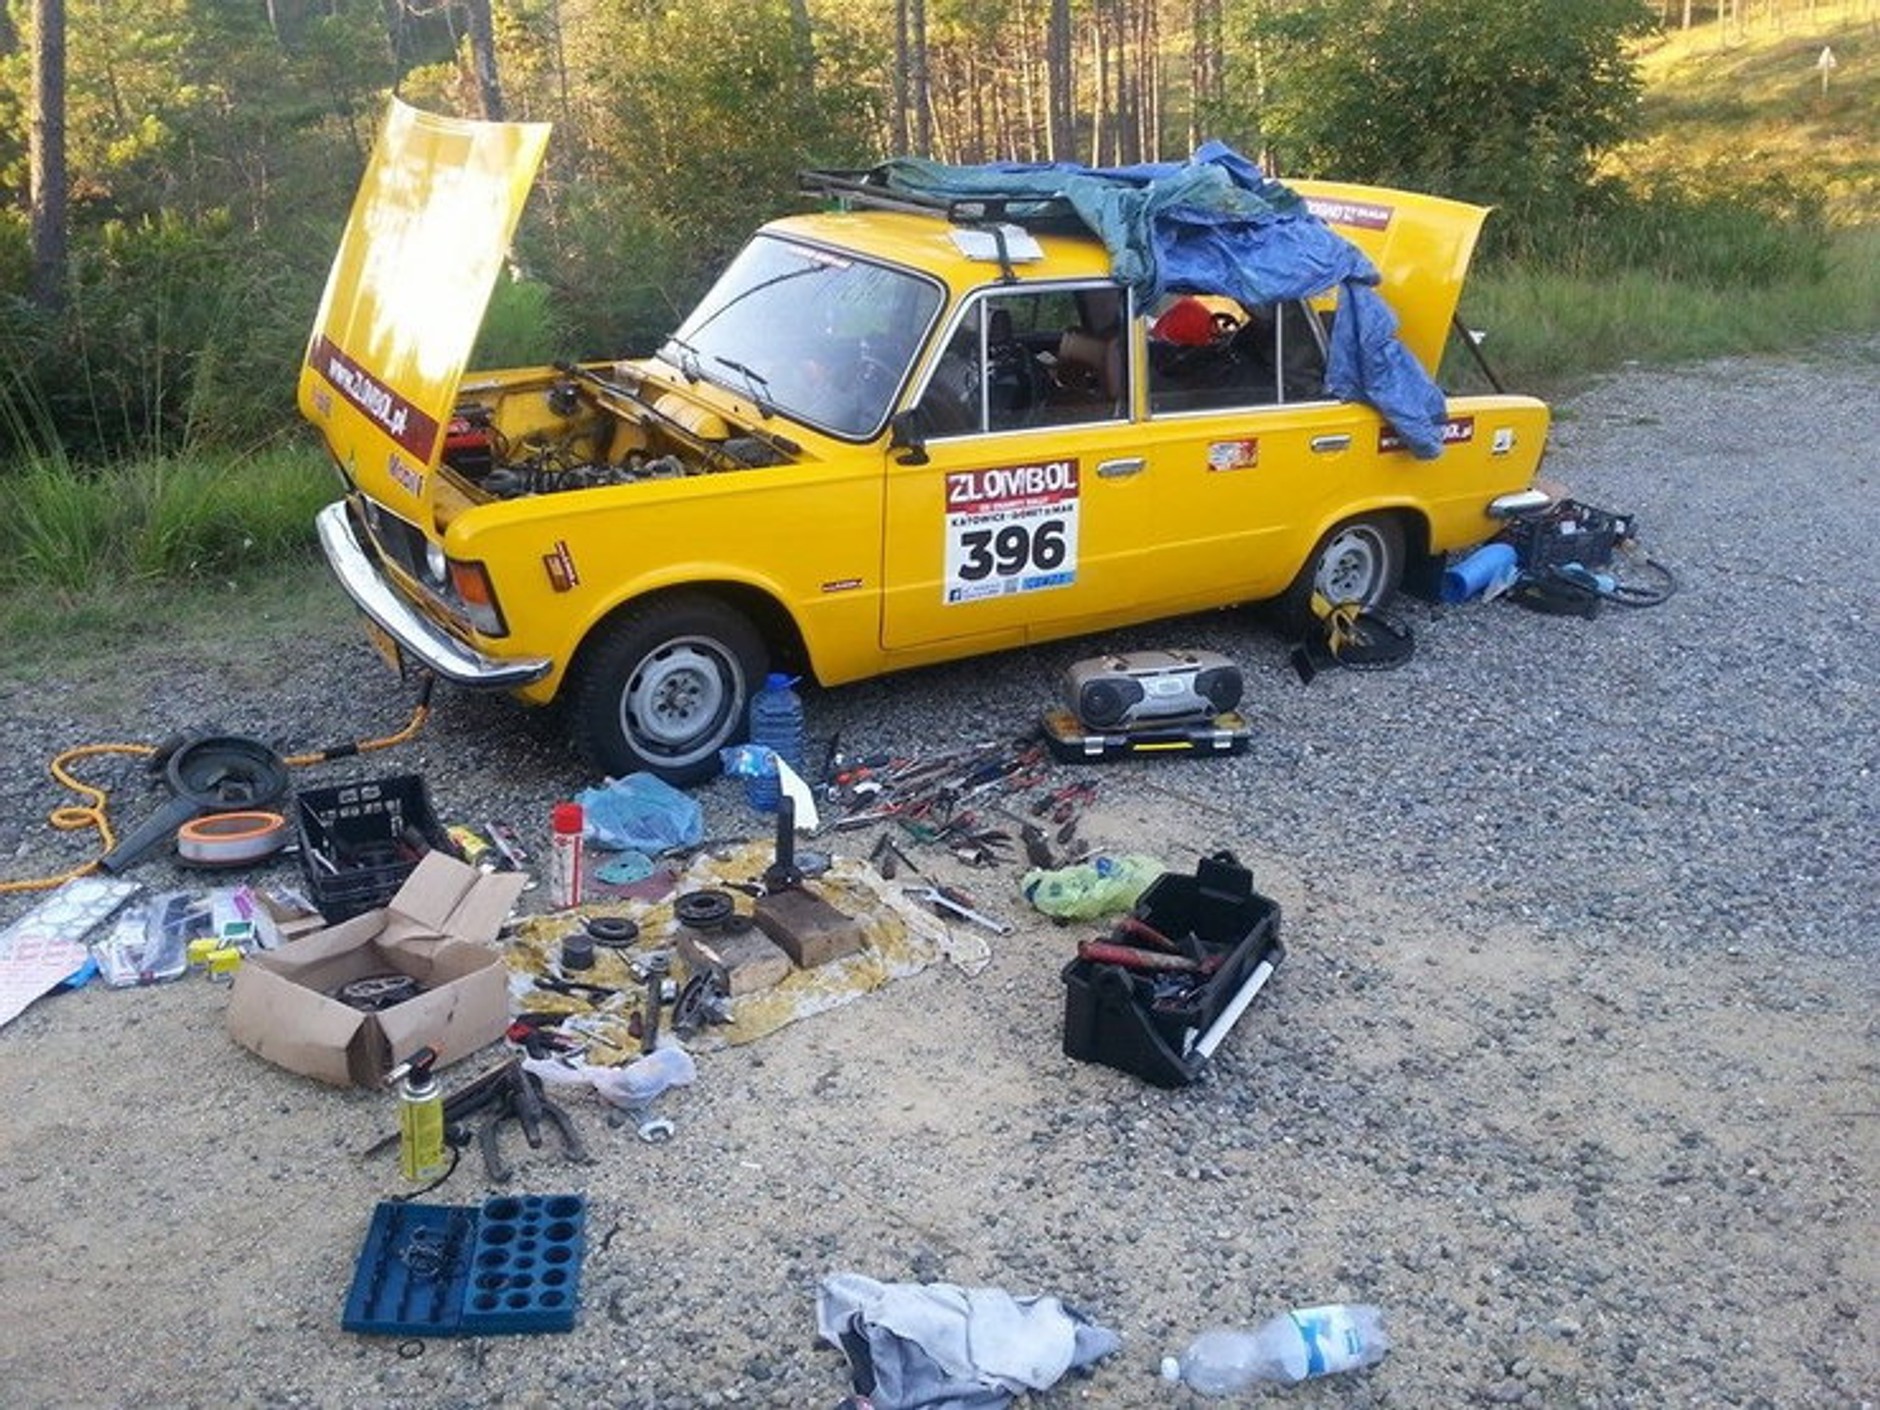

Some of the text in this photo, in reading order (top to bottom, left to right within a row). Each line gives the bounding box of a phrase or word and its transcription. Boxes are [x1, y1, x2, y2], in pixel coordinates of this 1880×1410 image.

[949, 461, 1078, 502] ZLOMBOL
[952, 512, 1005, 527] KATOWICE
[958, 520, 1066, 581] 396
